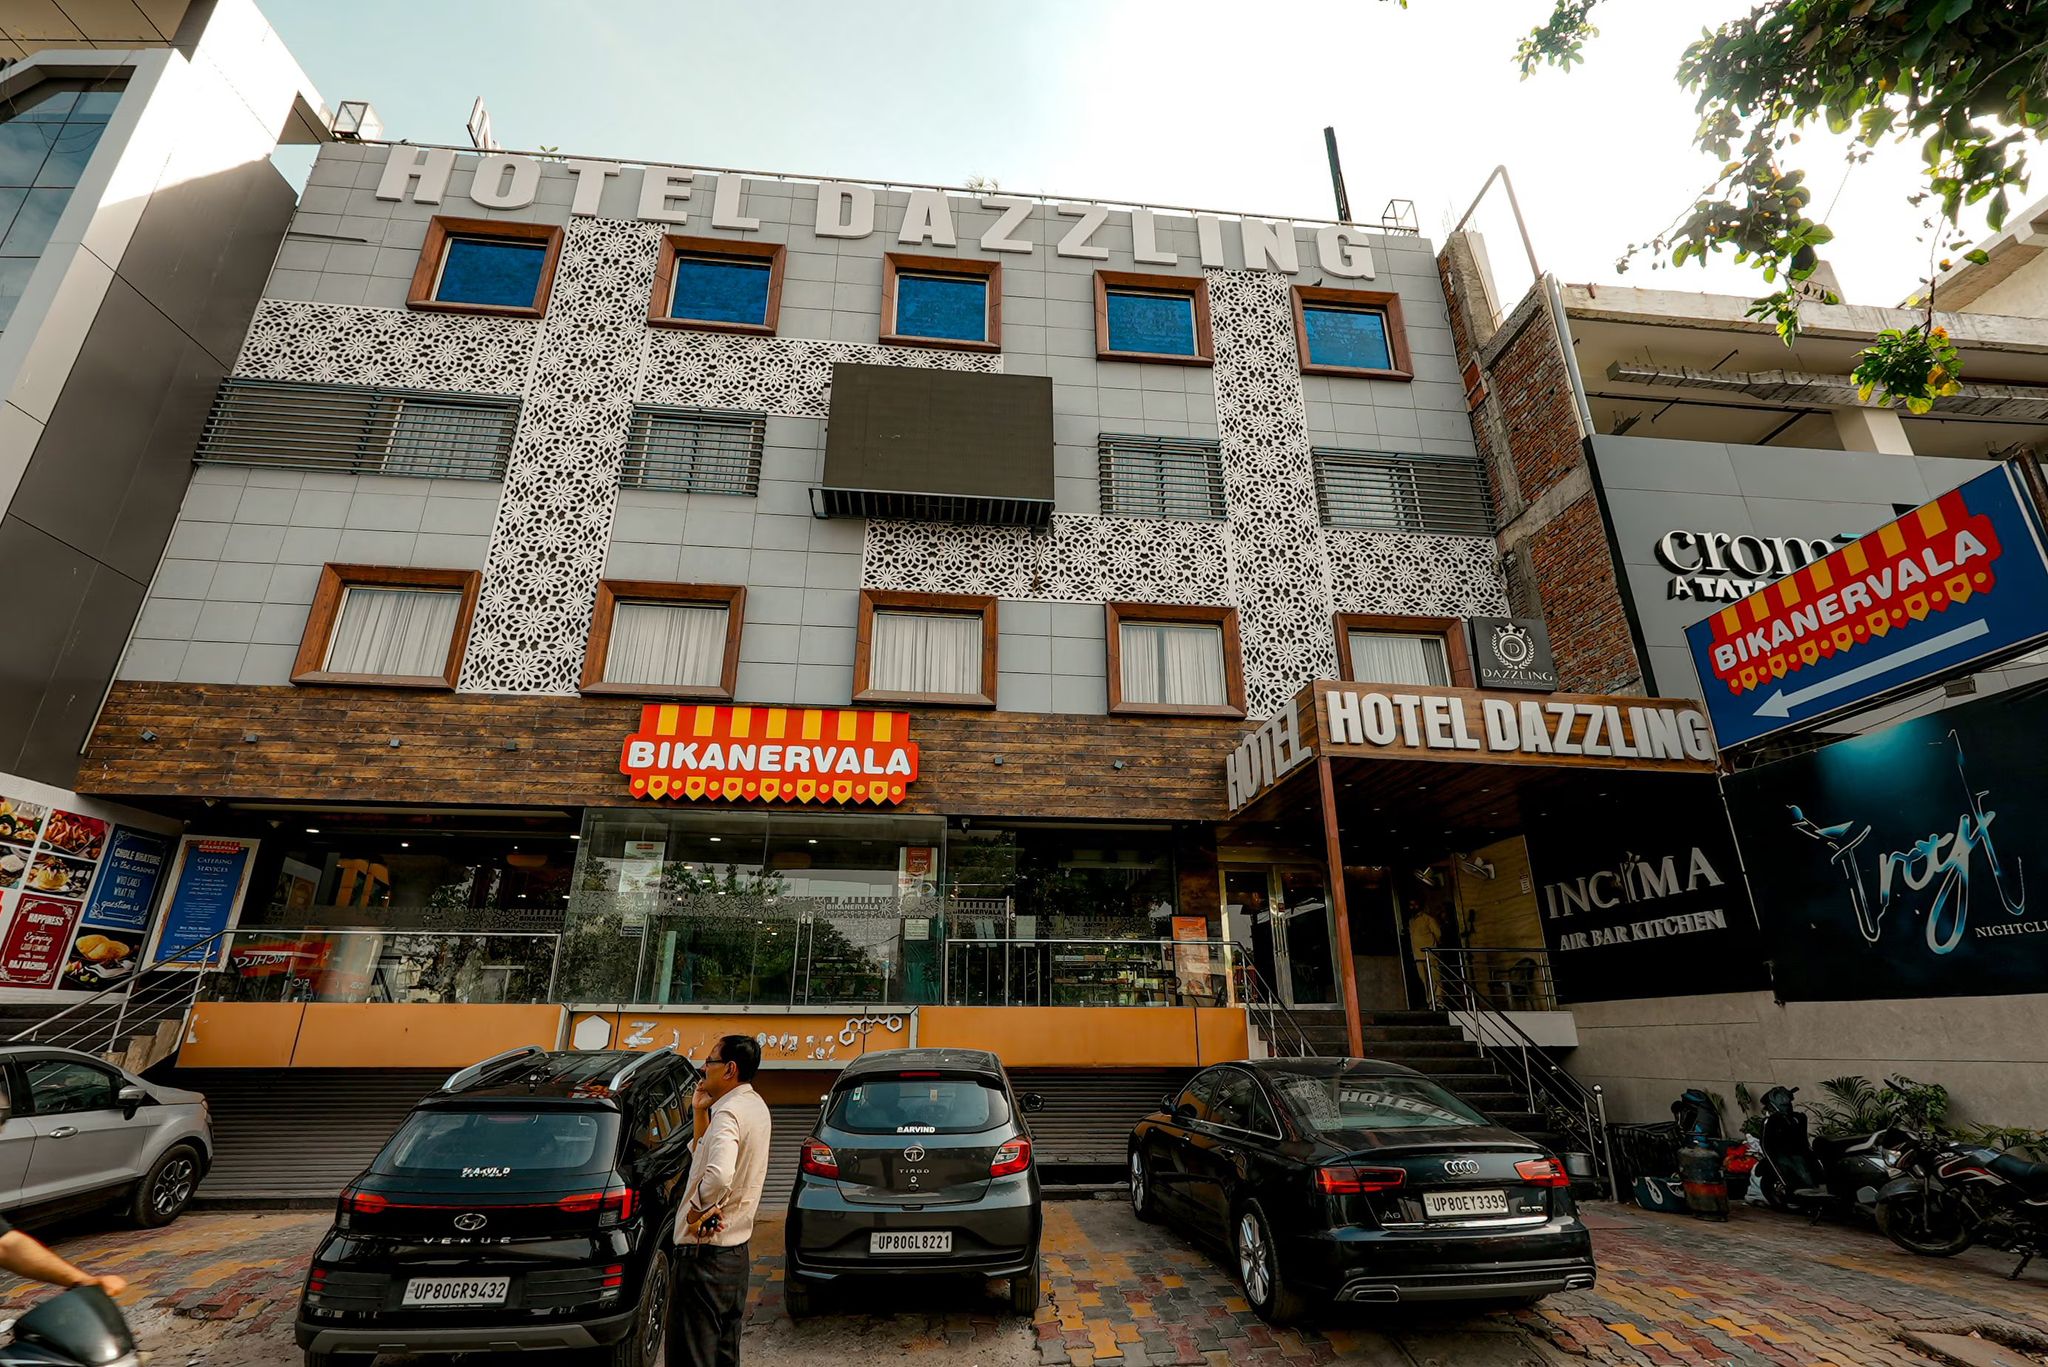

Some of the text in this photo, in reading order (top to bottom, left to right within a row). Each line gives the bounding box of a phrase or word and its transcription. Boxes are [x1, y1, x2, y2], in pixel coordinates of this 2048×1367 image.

[375, 145, 1376, 281] HOTEL DAZZLING
[1656, 530, 1860, 577] crom
[1669, 576, 1693, 599] A
[1714, 530, 1987, 672] BIKANERVALA
[1482, 668, 1553, 681] DAZZLING
[1326, 691, 1715, 762] HOTEL DAZZLING
[627, 741, 911, 775] BIKANERVALA
[1225, 700, 1312, 812] HOTEL
[1560, 908, 1728, 951] AIR BAR KITCHEN
[1431, 1194, 1507, 1212] UP80EY3399
[423, 1237, 511, 1245] VENUE
[878, 1235, 950, 1250] UP80GL8221
[414, 1282, 506, 1299] UP80GR9432
